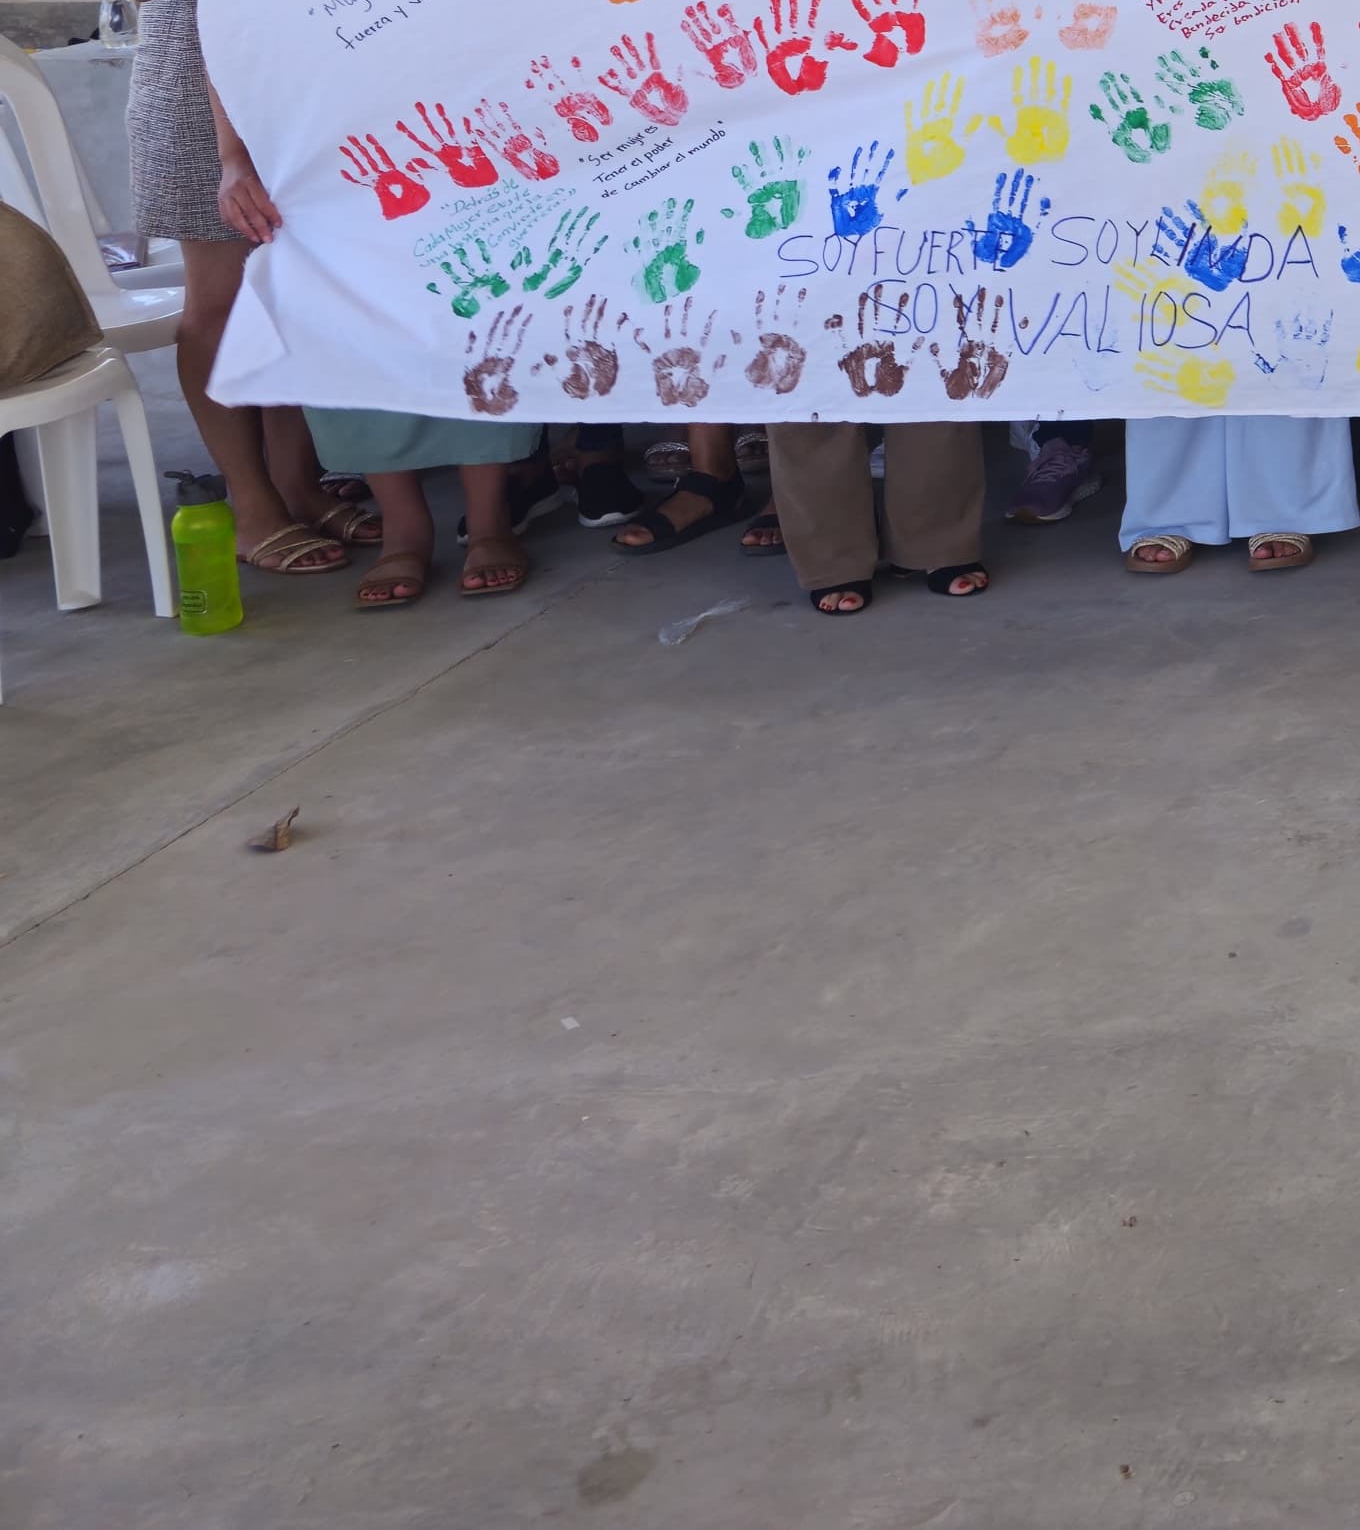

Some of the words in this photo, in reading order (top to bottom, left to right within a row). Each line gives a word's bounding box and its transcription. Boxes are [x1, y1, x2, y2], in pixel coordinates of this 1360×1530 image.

[336, 16, 393, 50] fuerza
[643, 125, 659, 135] es
[631, 157, 644, 168] el
[643, 137, 675, 163] poder
[502, 177, 520, 195] de
[601, 189, 619, 199] de
[675, 152, 687, 164] el
[777, 233, 863, 278] SOY
[872, 226, 1016, 276] FUERTE
[1051, 216, 1150, 267] SOY
[1150, 216, 1320, 283] LINDA
[865, 278, 985, 348] SOY
[1008, 284, 1256, 355] VALIOSA
